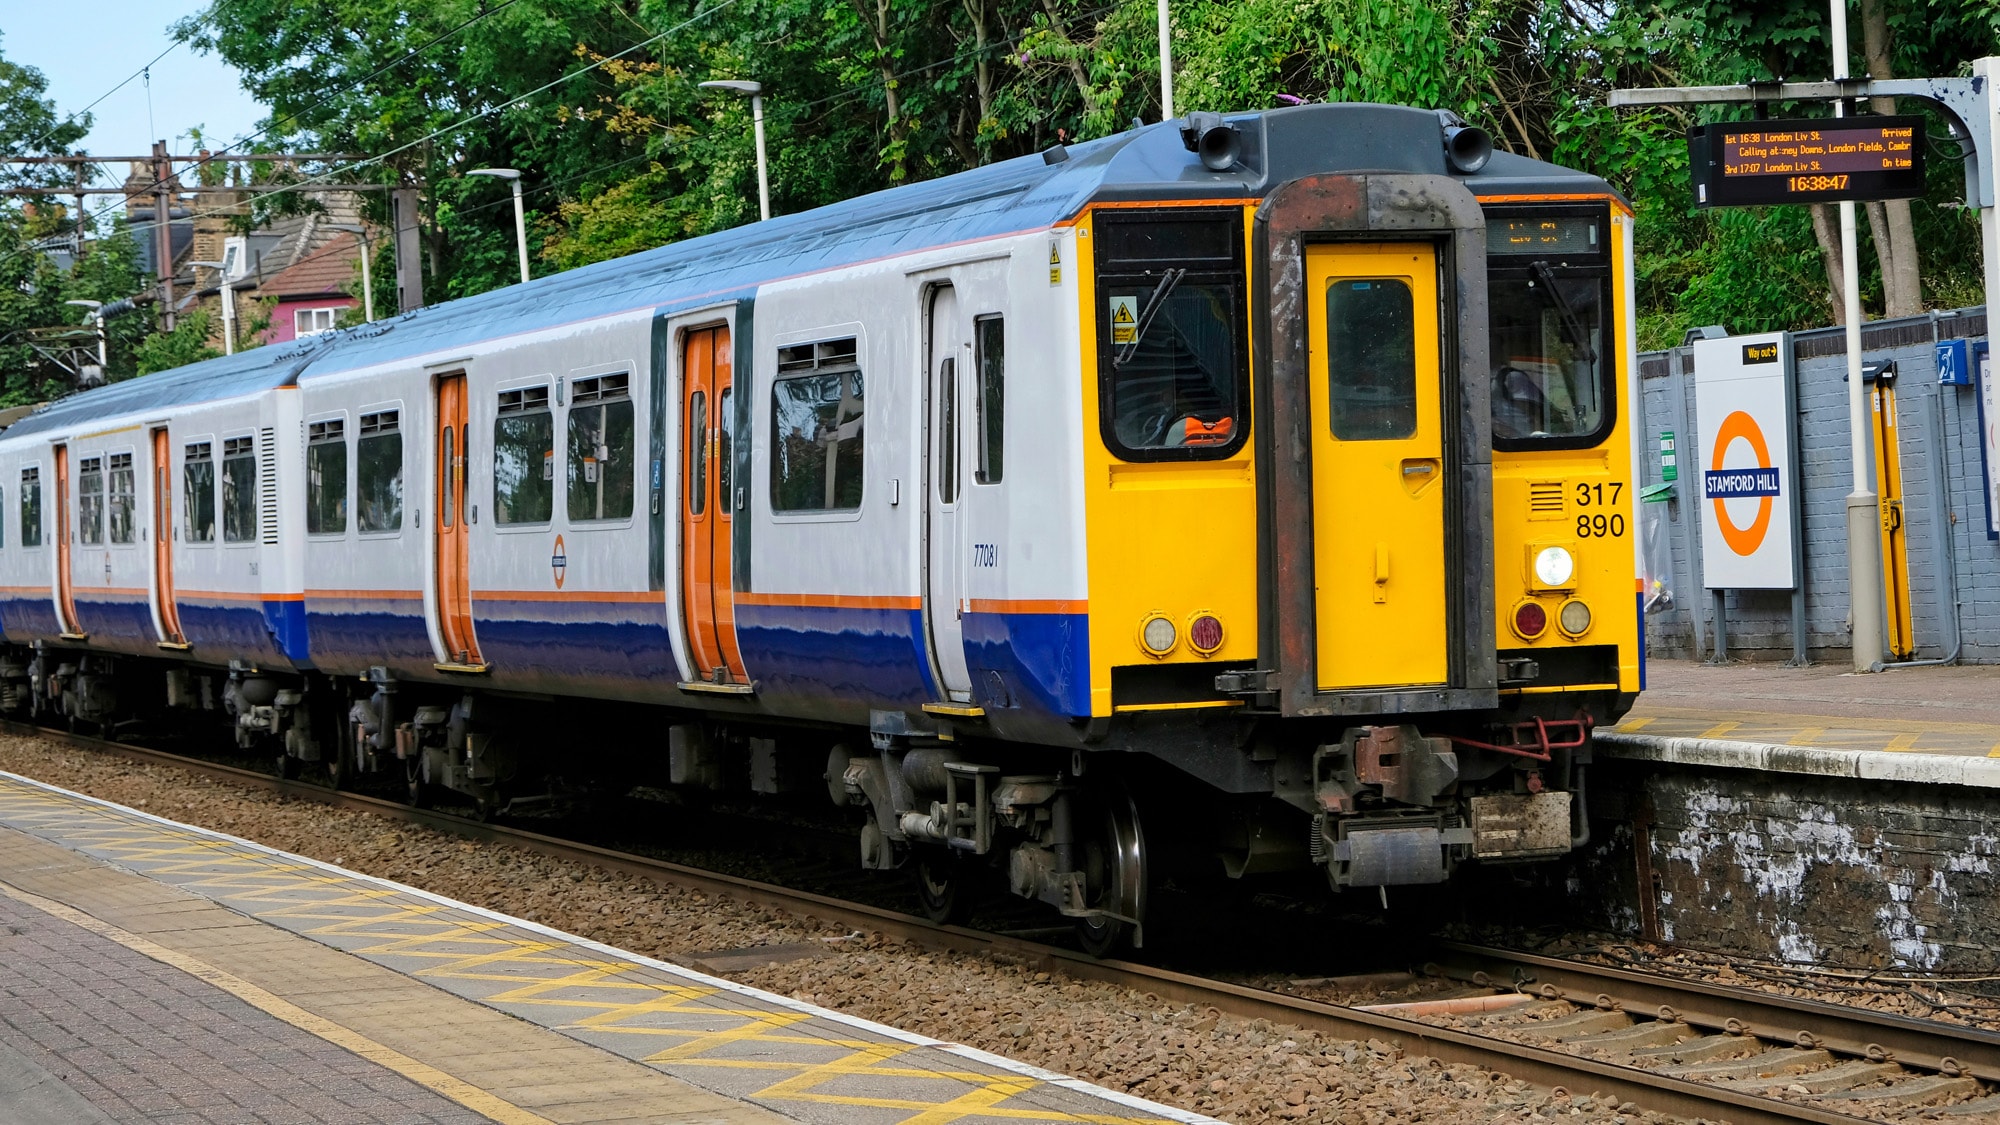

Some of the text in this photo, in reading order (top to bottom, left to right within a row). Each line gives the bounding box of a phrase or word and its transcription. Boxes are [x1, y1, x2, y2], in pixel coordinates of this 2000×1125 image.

[1725, 127, 1912, 144] 1st 16:38 London Liv St. Arrived
[1739, 146, 1767, 158] Calling
[1828, 143, 1856, 153] London
[1858, 142, 1886, 152] Fields,
[1725, 158, 1912, 174] 3rd 17:07 London Liv St. On time
[1790, 175, 1848, 191] 16:38:47
[1748, 347, 1771, 360] Way out
[1707, 474, 1778, 493] STAMFORD HILL
[1576, 482, 1623, 506] 317
[1576, 514, 1624, 538] 890
[974, 544, 998, 568] 77081
